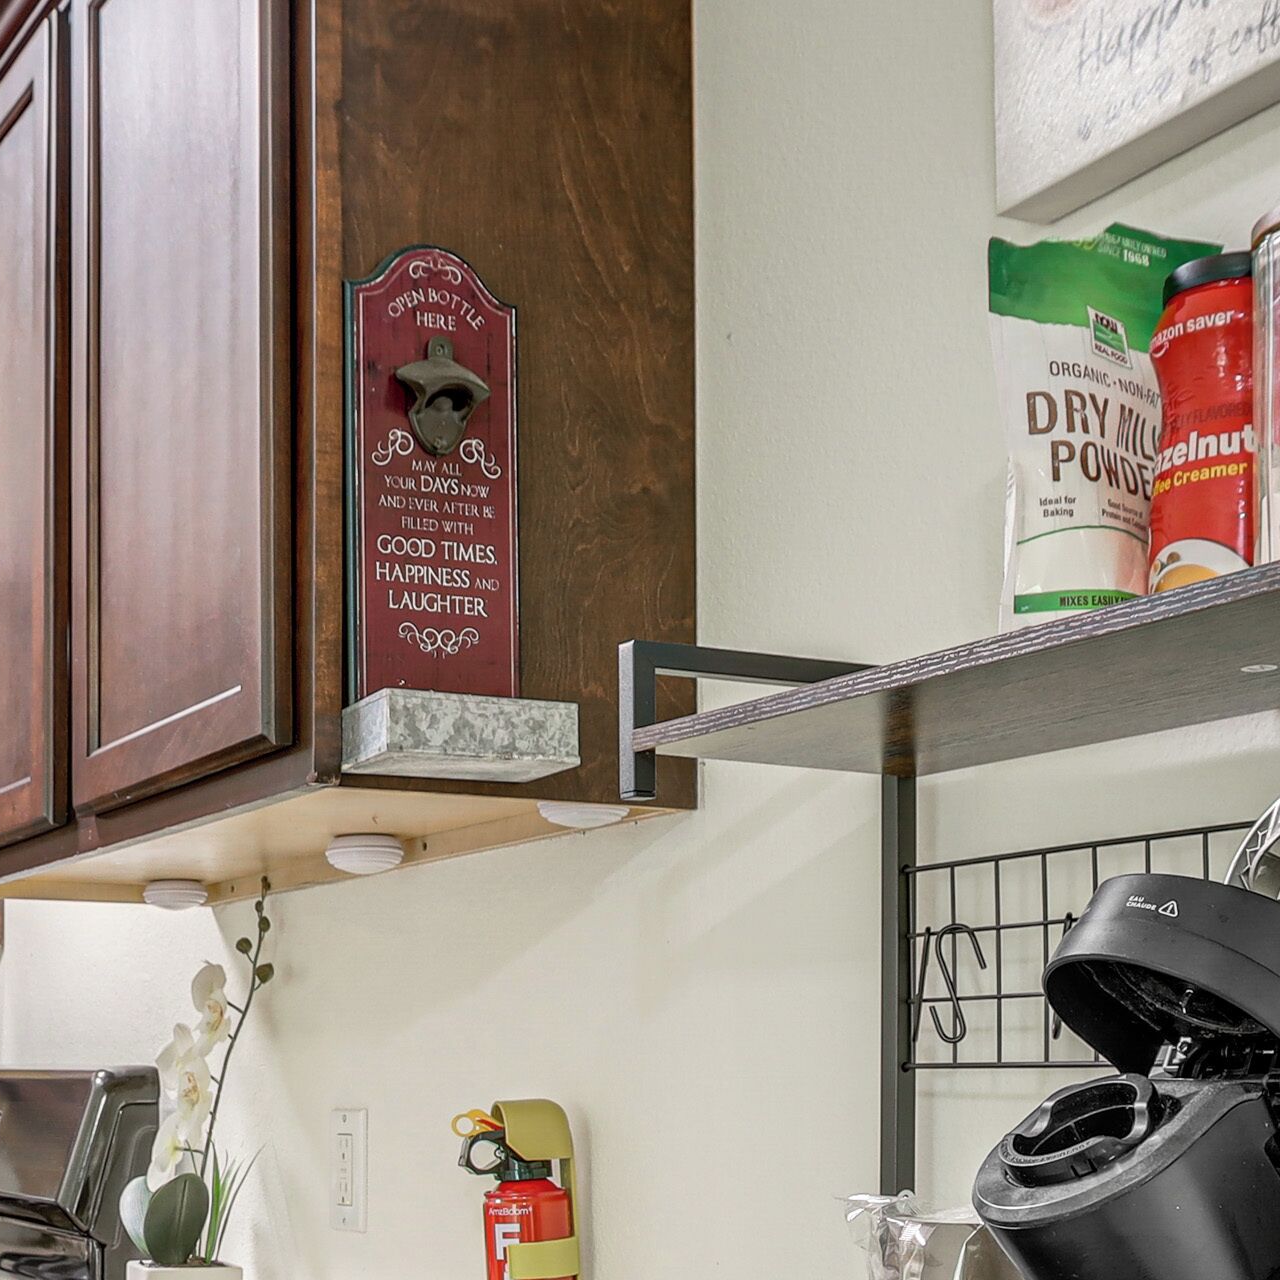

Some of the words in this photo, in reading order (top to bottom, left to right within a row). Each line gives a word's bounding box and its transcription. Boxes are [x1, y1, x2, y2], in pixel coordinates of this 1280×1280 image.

[388, 288, 425, 317] OPEN
[428, 288, 485, 330] BOTTLE
[416, 311, 457, 331] HERE
[1150, 322, 1184, 349] mazon
[1186, 310, 1235, 332] saver
[1049, 361, 1111, 388] ORGANIC
[1118, 378, 1161, 409] NON-FAT
[1026, 389, 1109, 439] DRY
[1153, 424, 1259, 477] azelnut
[411, 459, 437, 472] MAY
[441, 462, 463, 477] ALL
[1050, 440, 1155, 502] POWDE
[1152, 476, 1171, 498] ffee
[1173, 461, 1249, 487] Creamer
[384, 475, 417, 491] YOUR
[420, 475, 459, 496] DAYS
[460, 485, 491, 498] NOW
[378, 494, 406, 509] AND
[408, 497, 439, 514] EVER
[442, 502, 480, 518] AFTER
[482, 506, 496, 519] BE
[1039, 496, 1062, 507] Ideal
[1064, 495, 1077, 505] for
[1043, 507, 1075, 518] Baking
[401, 516, 439, 531] FILLED
[441, 520, 474, 535] WITH
[377, 534, 436, 559] GOOD
[376, 562, 470, 588] HAPPINESS
[474, 578, 500, 591] AND
[388, 589, 488, 617] LAUGHTER
[1059, 595, 1089, 607] MIXES
[1126, 901, 1157, 911] CHAUDE
